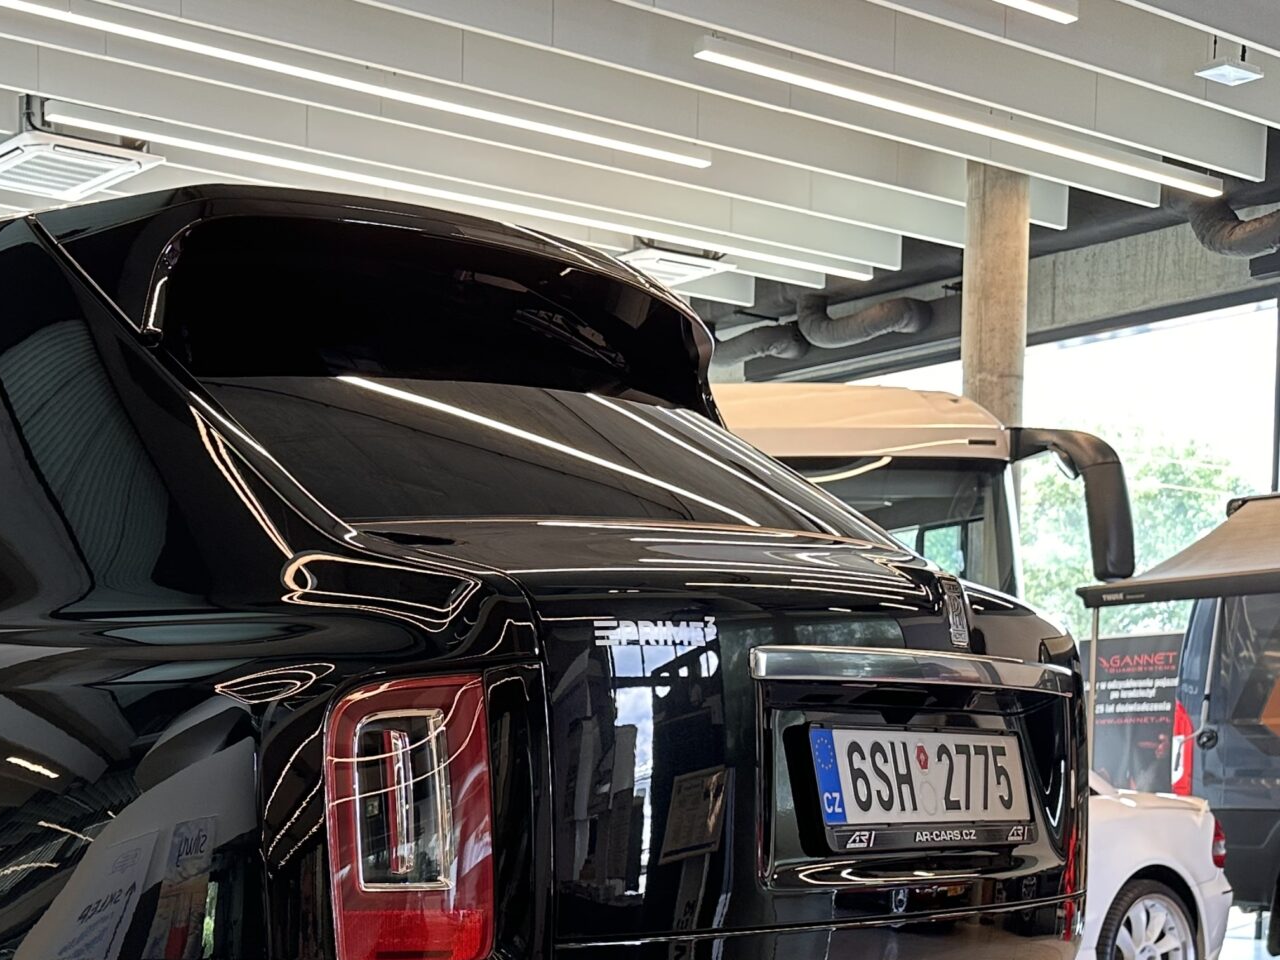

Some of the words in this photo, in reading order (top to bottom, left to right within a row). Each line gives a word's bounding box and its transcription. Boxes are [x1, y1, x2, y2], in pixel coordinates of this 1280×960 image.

[1109, 652, 1178, 668] GANNET
[847, 741, 918, 812] 6SH
[936, 743, 1013, 812] 2775
[823, 792, 843, 814] CZ
[915, 829, 977, 842] AR-CARS.CZ
